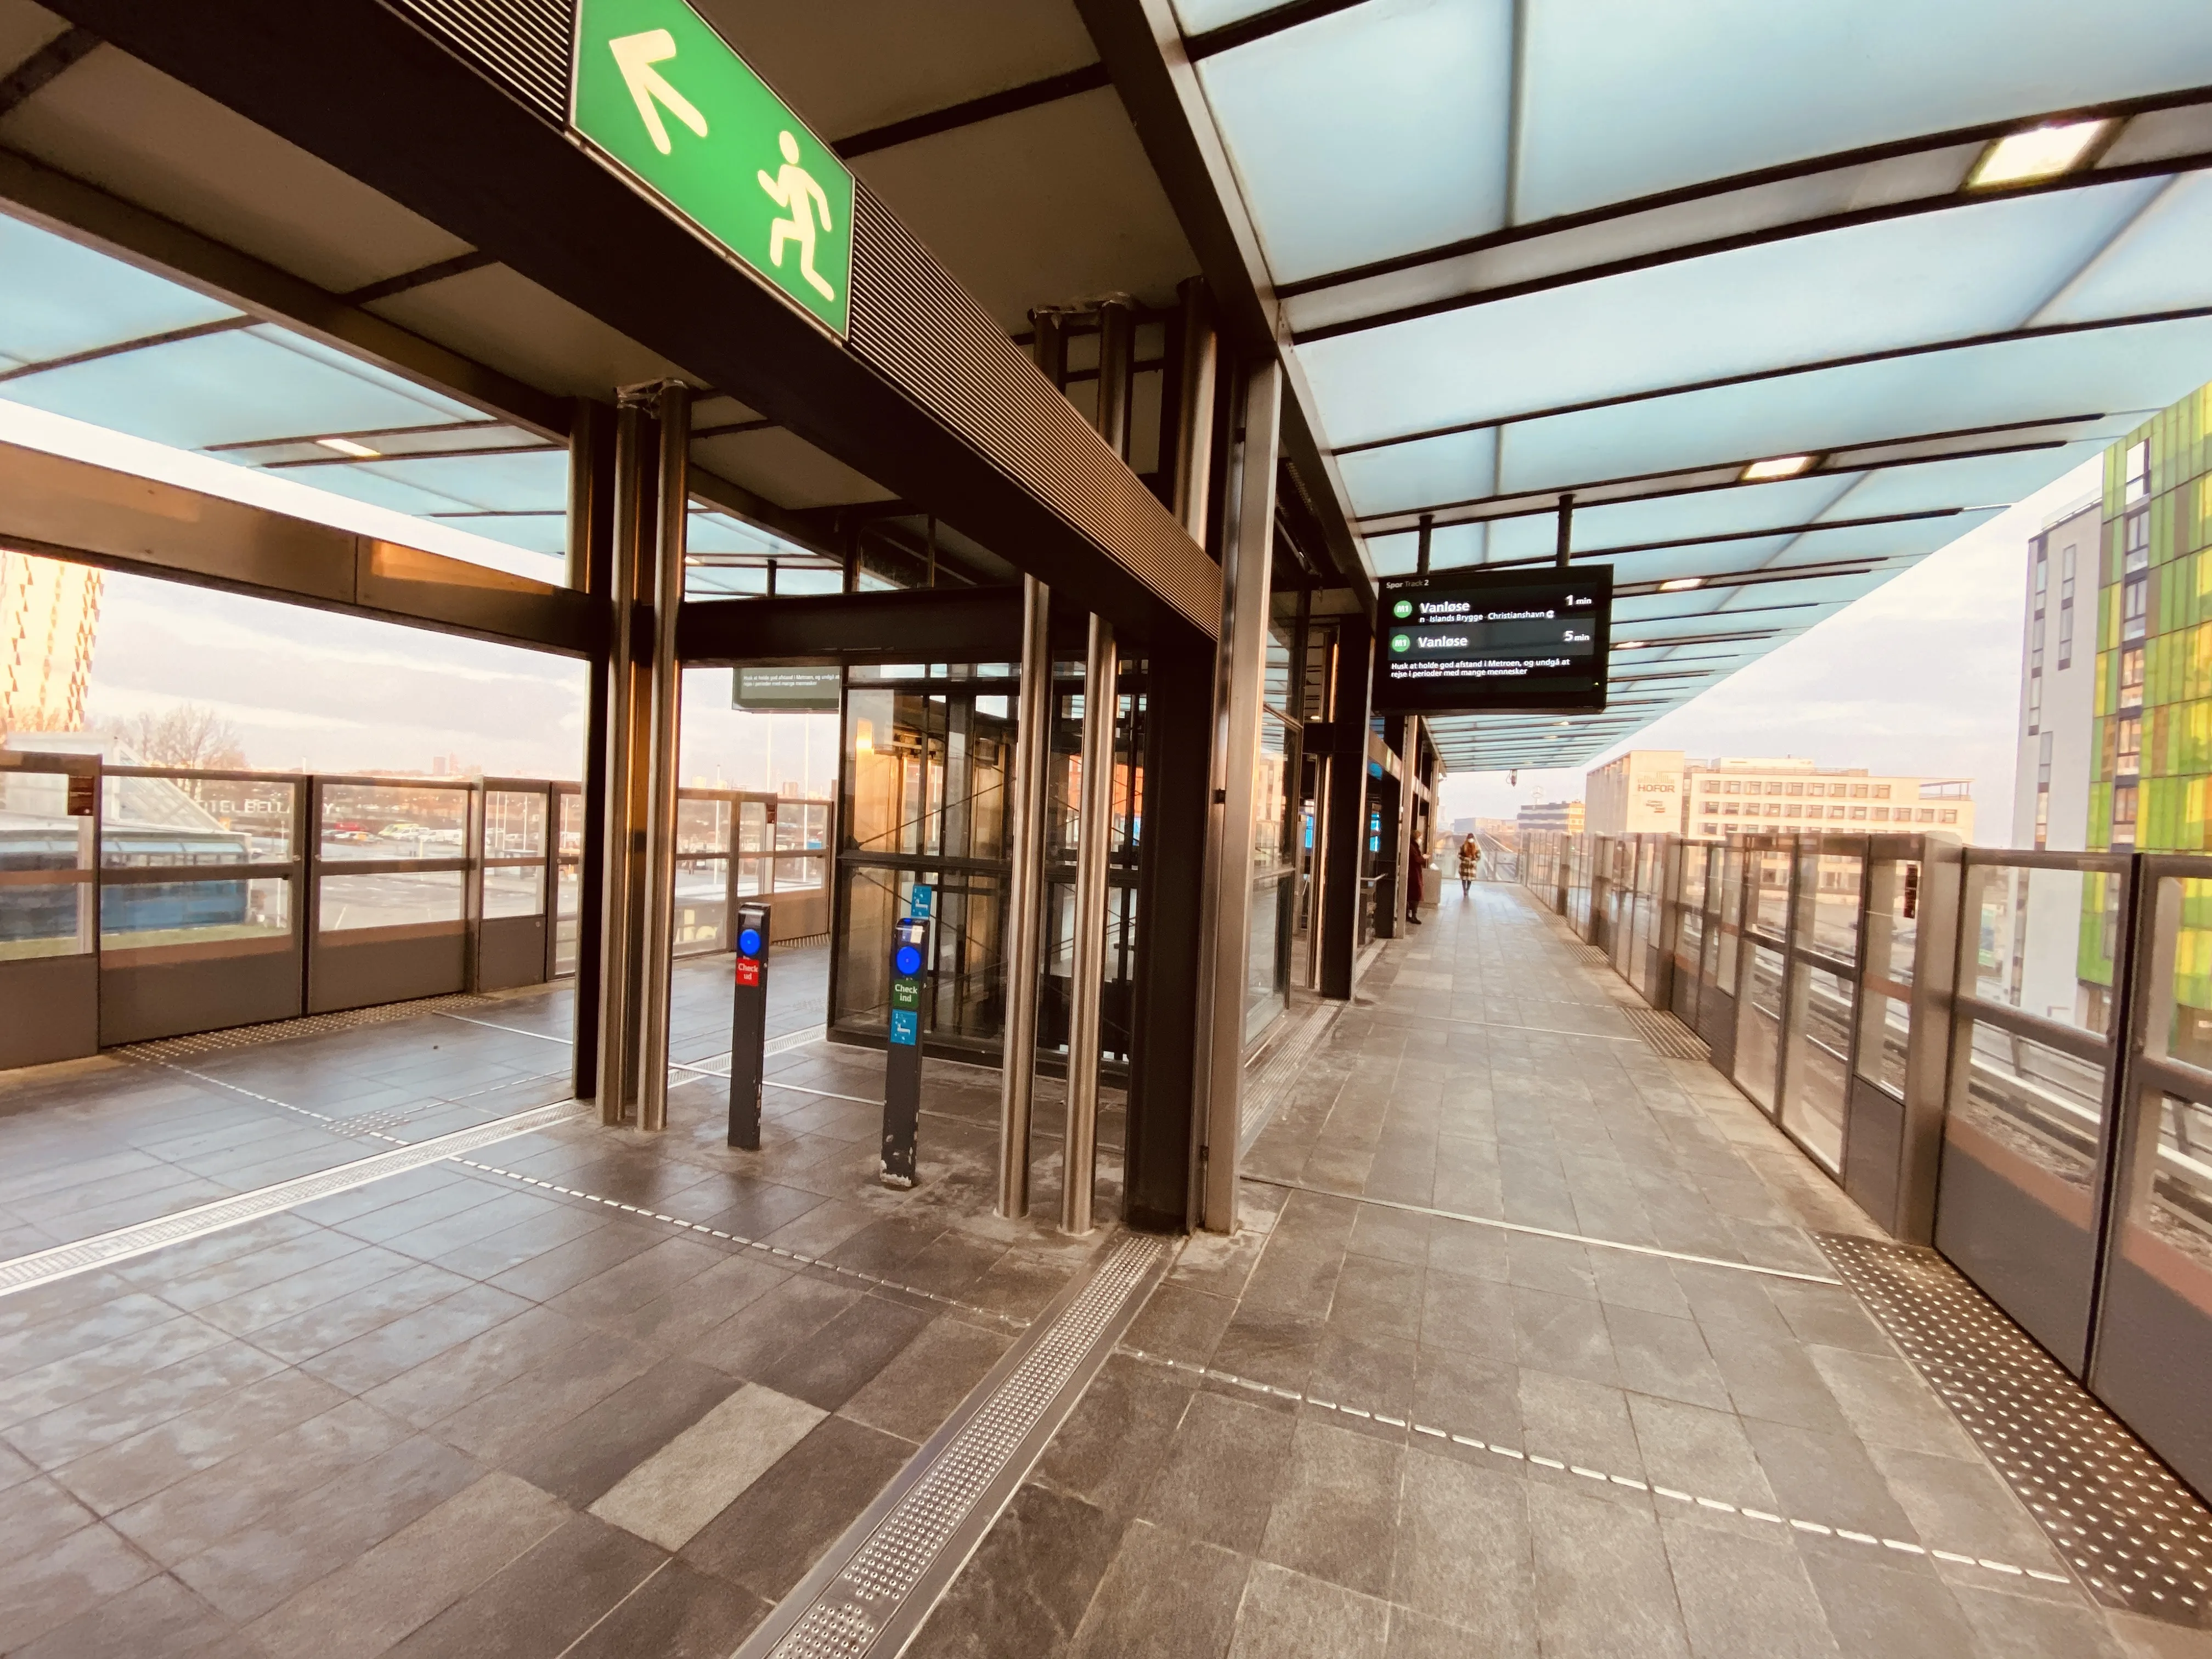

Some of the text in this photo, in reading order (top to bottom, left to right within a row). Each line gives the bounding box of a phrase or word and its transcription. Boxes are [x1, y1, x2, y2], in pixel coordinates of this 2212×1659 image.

[1420, 601, 1470, 613] Vanløse
[1566, 595, 1573, 606] 1
[1456, 614, 1483, 623] Brygge
[1488, 611, 1544, 620] Christianshavn
[1418, 636, 1468, 647] Vanløse
[1565, 630, 1573, 641] 5
[1440, 661, 1454, 670] god
[1536, 658, 1560, 667] undgå
[1413, 670, 1442, 678] perioder
[1638, 785, 1675, 793] HOFOR
[198, 800, 240, 813] OTEL
[738, 963, 758, 972] Check
[895, 984, 917, 994] Check
[900, 994, 911, 1002] ind
